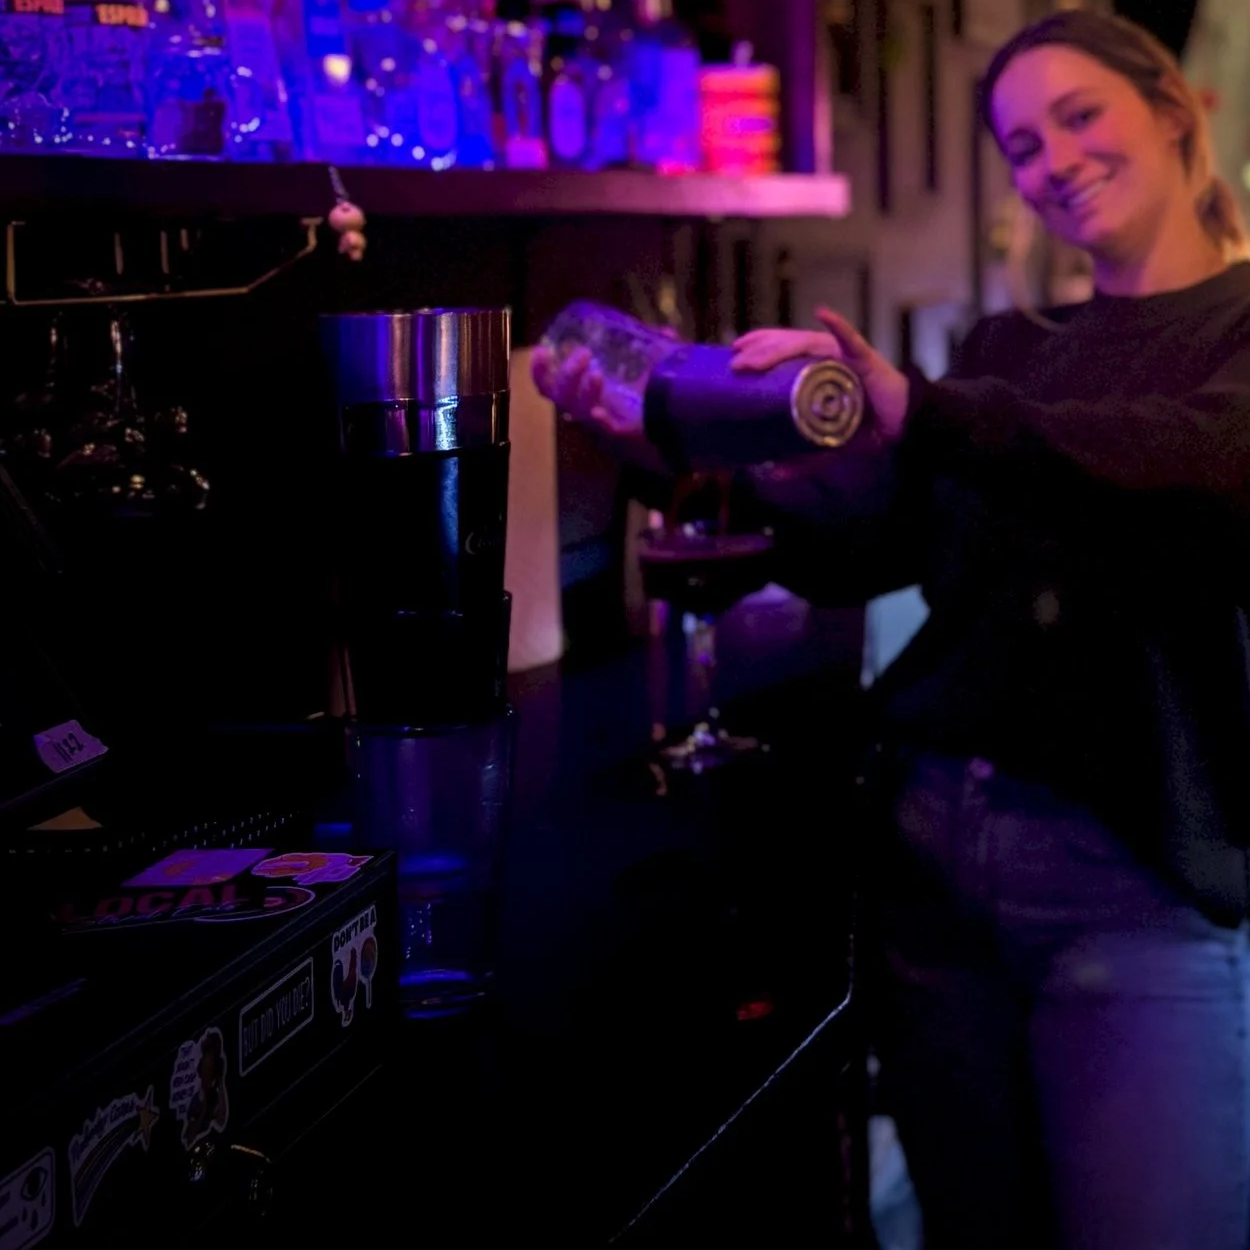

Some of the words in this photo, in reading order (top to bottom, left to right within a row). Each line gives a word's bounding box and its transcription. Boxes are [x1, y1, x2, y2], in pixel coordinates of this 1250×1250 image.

[242, 1017, 259, 1059] BUT
[260, 1007, 275, 1046] DID
[276, 989, 292, 1031] YOU
[292, 975, 311, 1017] DIE?
